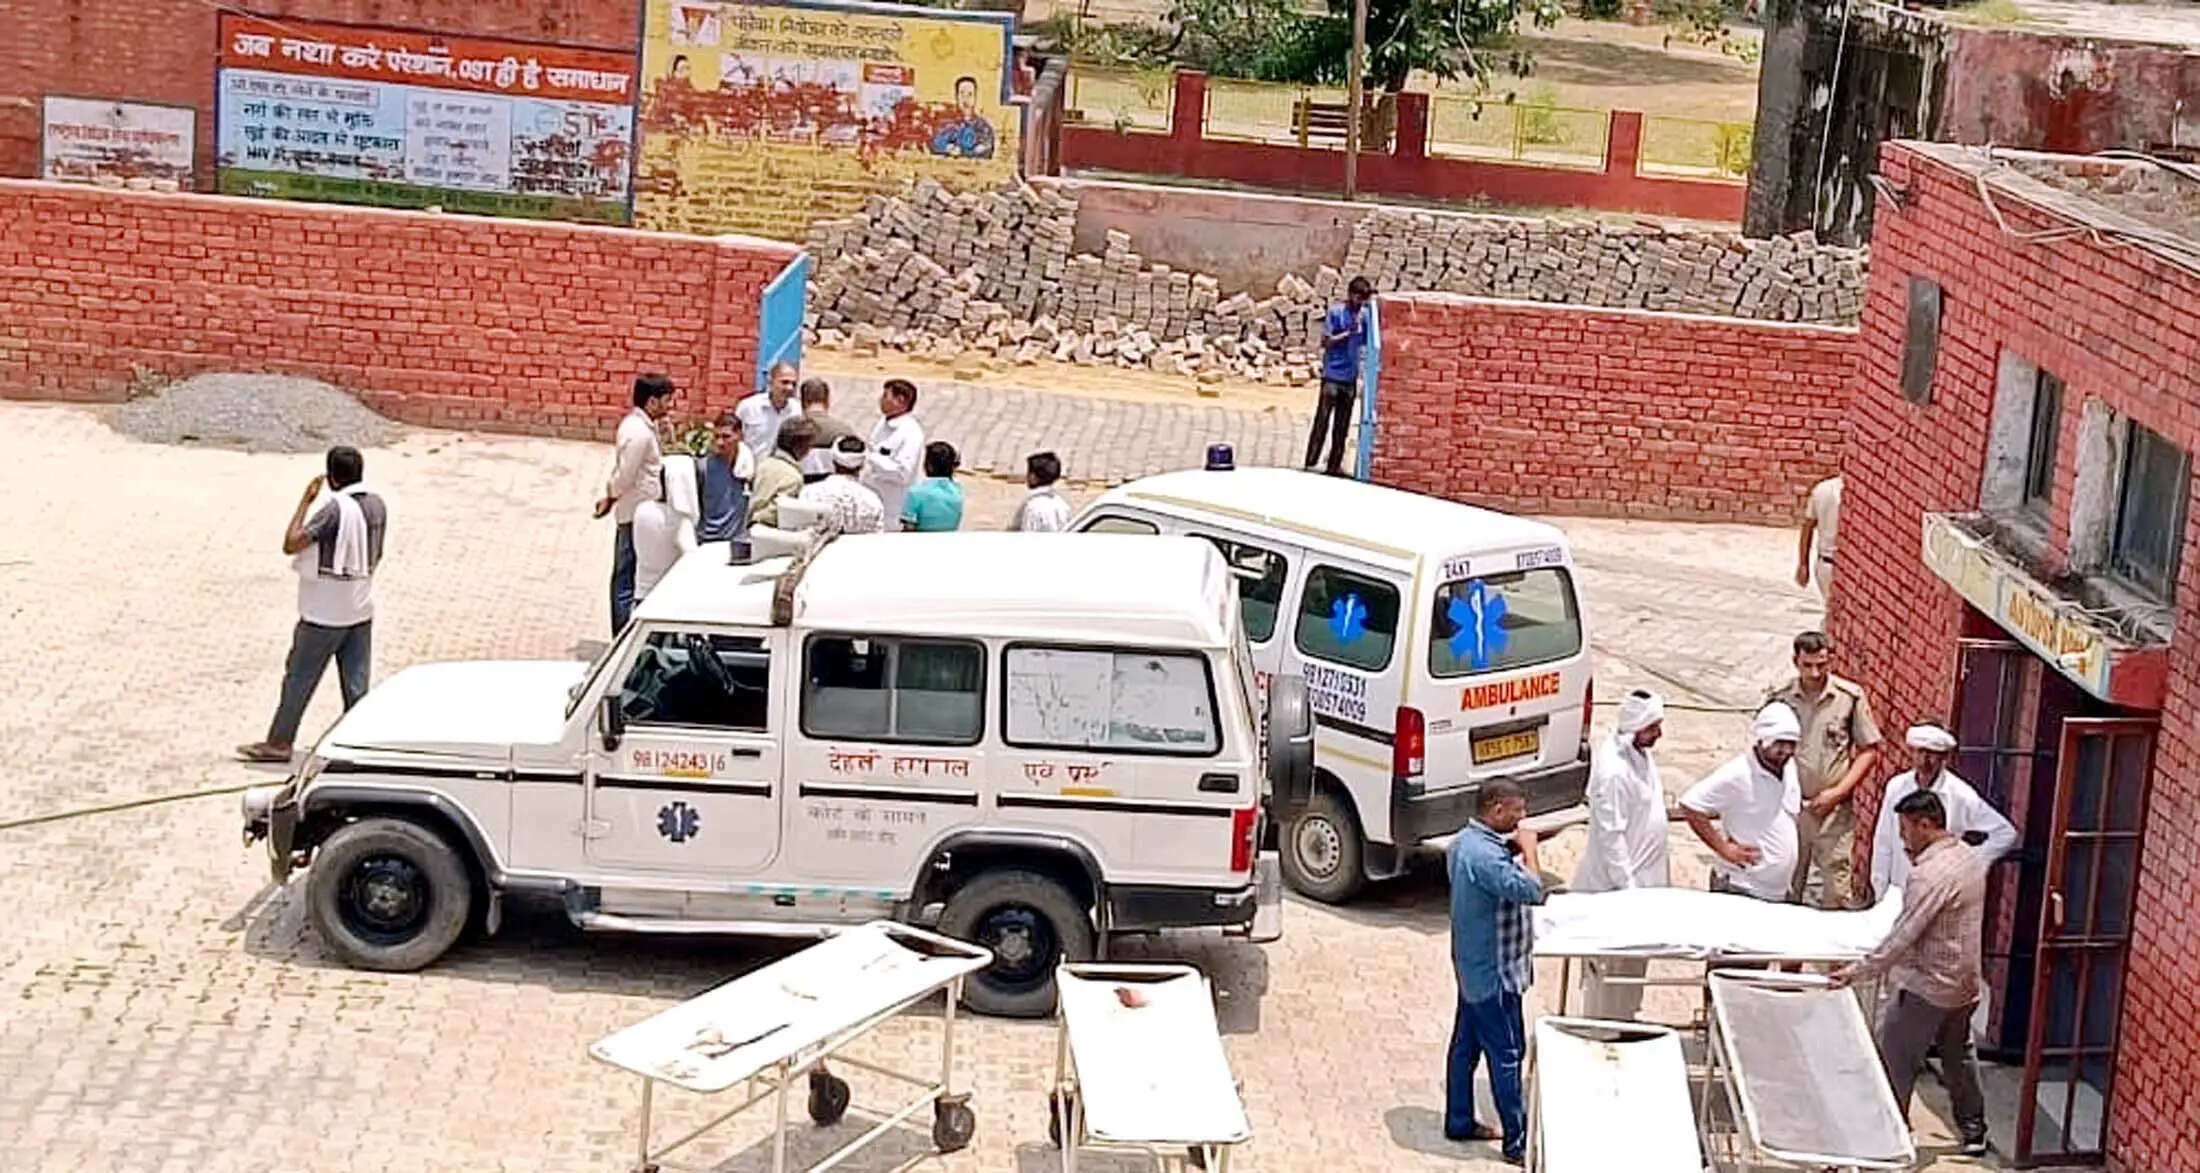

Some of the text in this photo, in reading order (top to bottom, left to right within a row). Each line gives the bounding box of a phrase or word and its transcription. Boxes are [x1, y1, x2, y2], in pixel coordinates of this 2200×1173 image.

[233, 33, 275, 57] अब
[495, 56, 519, 88] ही
[522, 58, 542, 89] है
[546, 67, 630, 94] समाधान
[1461, 671, 1561, 712] AMBULANCE
[633, 750, 725, 771] 9812424316
